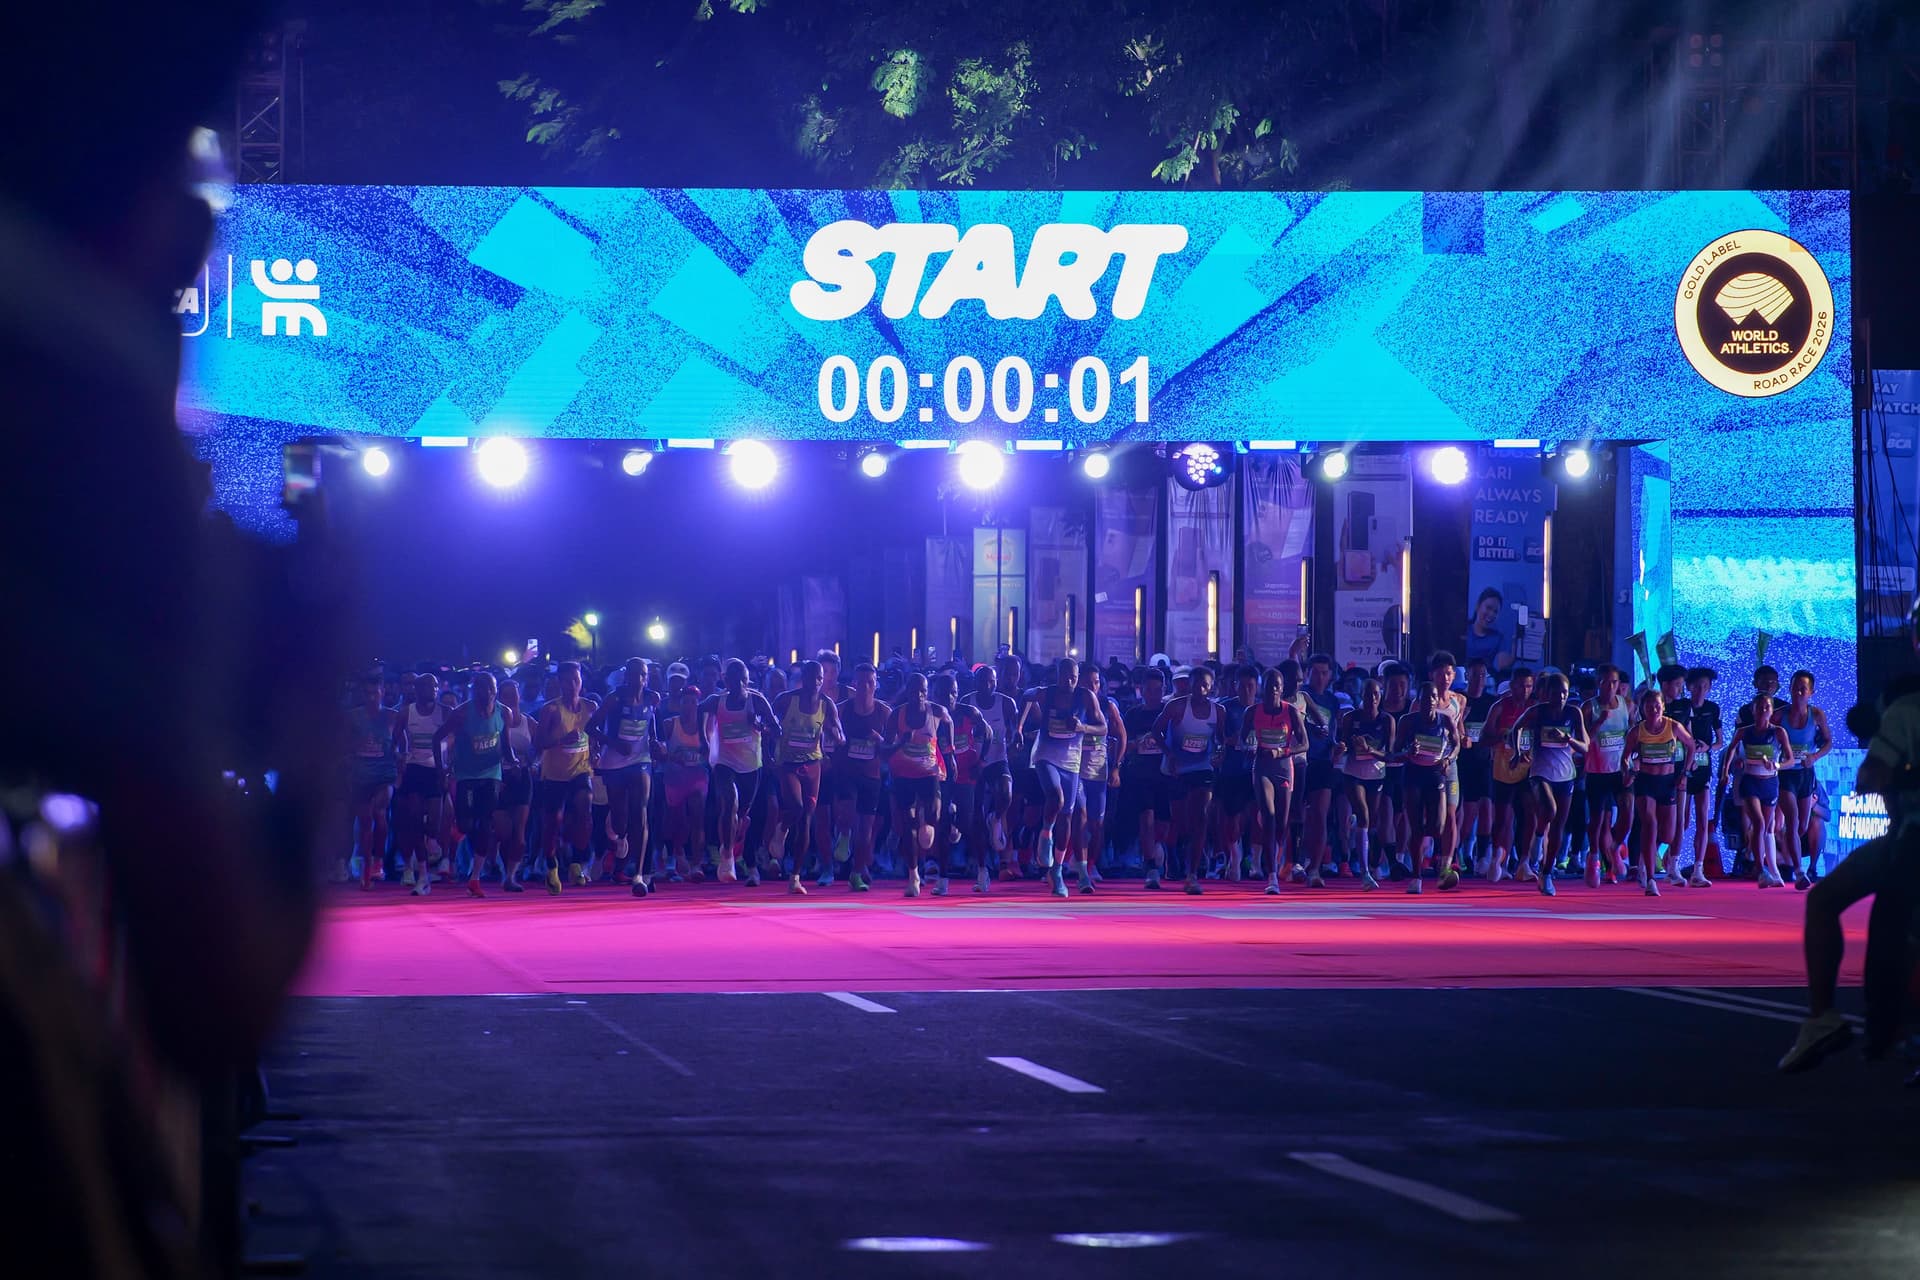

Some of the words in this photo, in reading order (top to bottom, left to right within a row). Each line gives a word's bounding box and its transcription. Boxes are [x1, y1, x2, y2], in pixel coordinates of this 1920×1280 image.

[789, 219, 1189, 321] START
[1684, 265, 1705, 300] GOLD
[1703, 240, 1741, 266] LABEL
[1731, 330, 1779, 341] WORLD
[1753, 373, 1788, 390] ROAD
[1789, 347, 1817, 377] RACE
[1812, 311, 1828, 346] 2026
[817, 354, 1150, 424] 00:00:01
[1475, 487, 1542, 503] ALWAYS
[1474, 509, 1529, 525] READY
[1479, 536, 1494, 546] DO
[1478, 548, 1515, 559] BETTER
